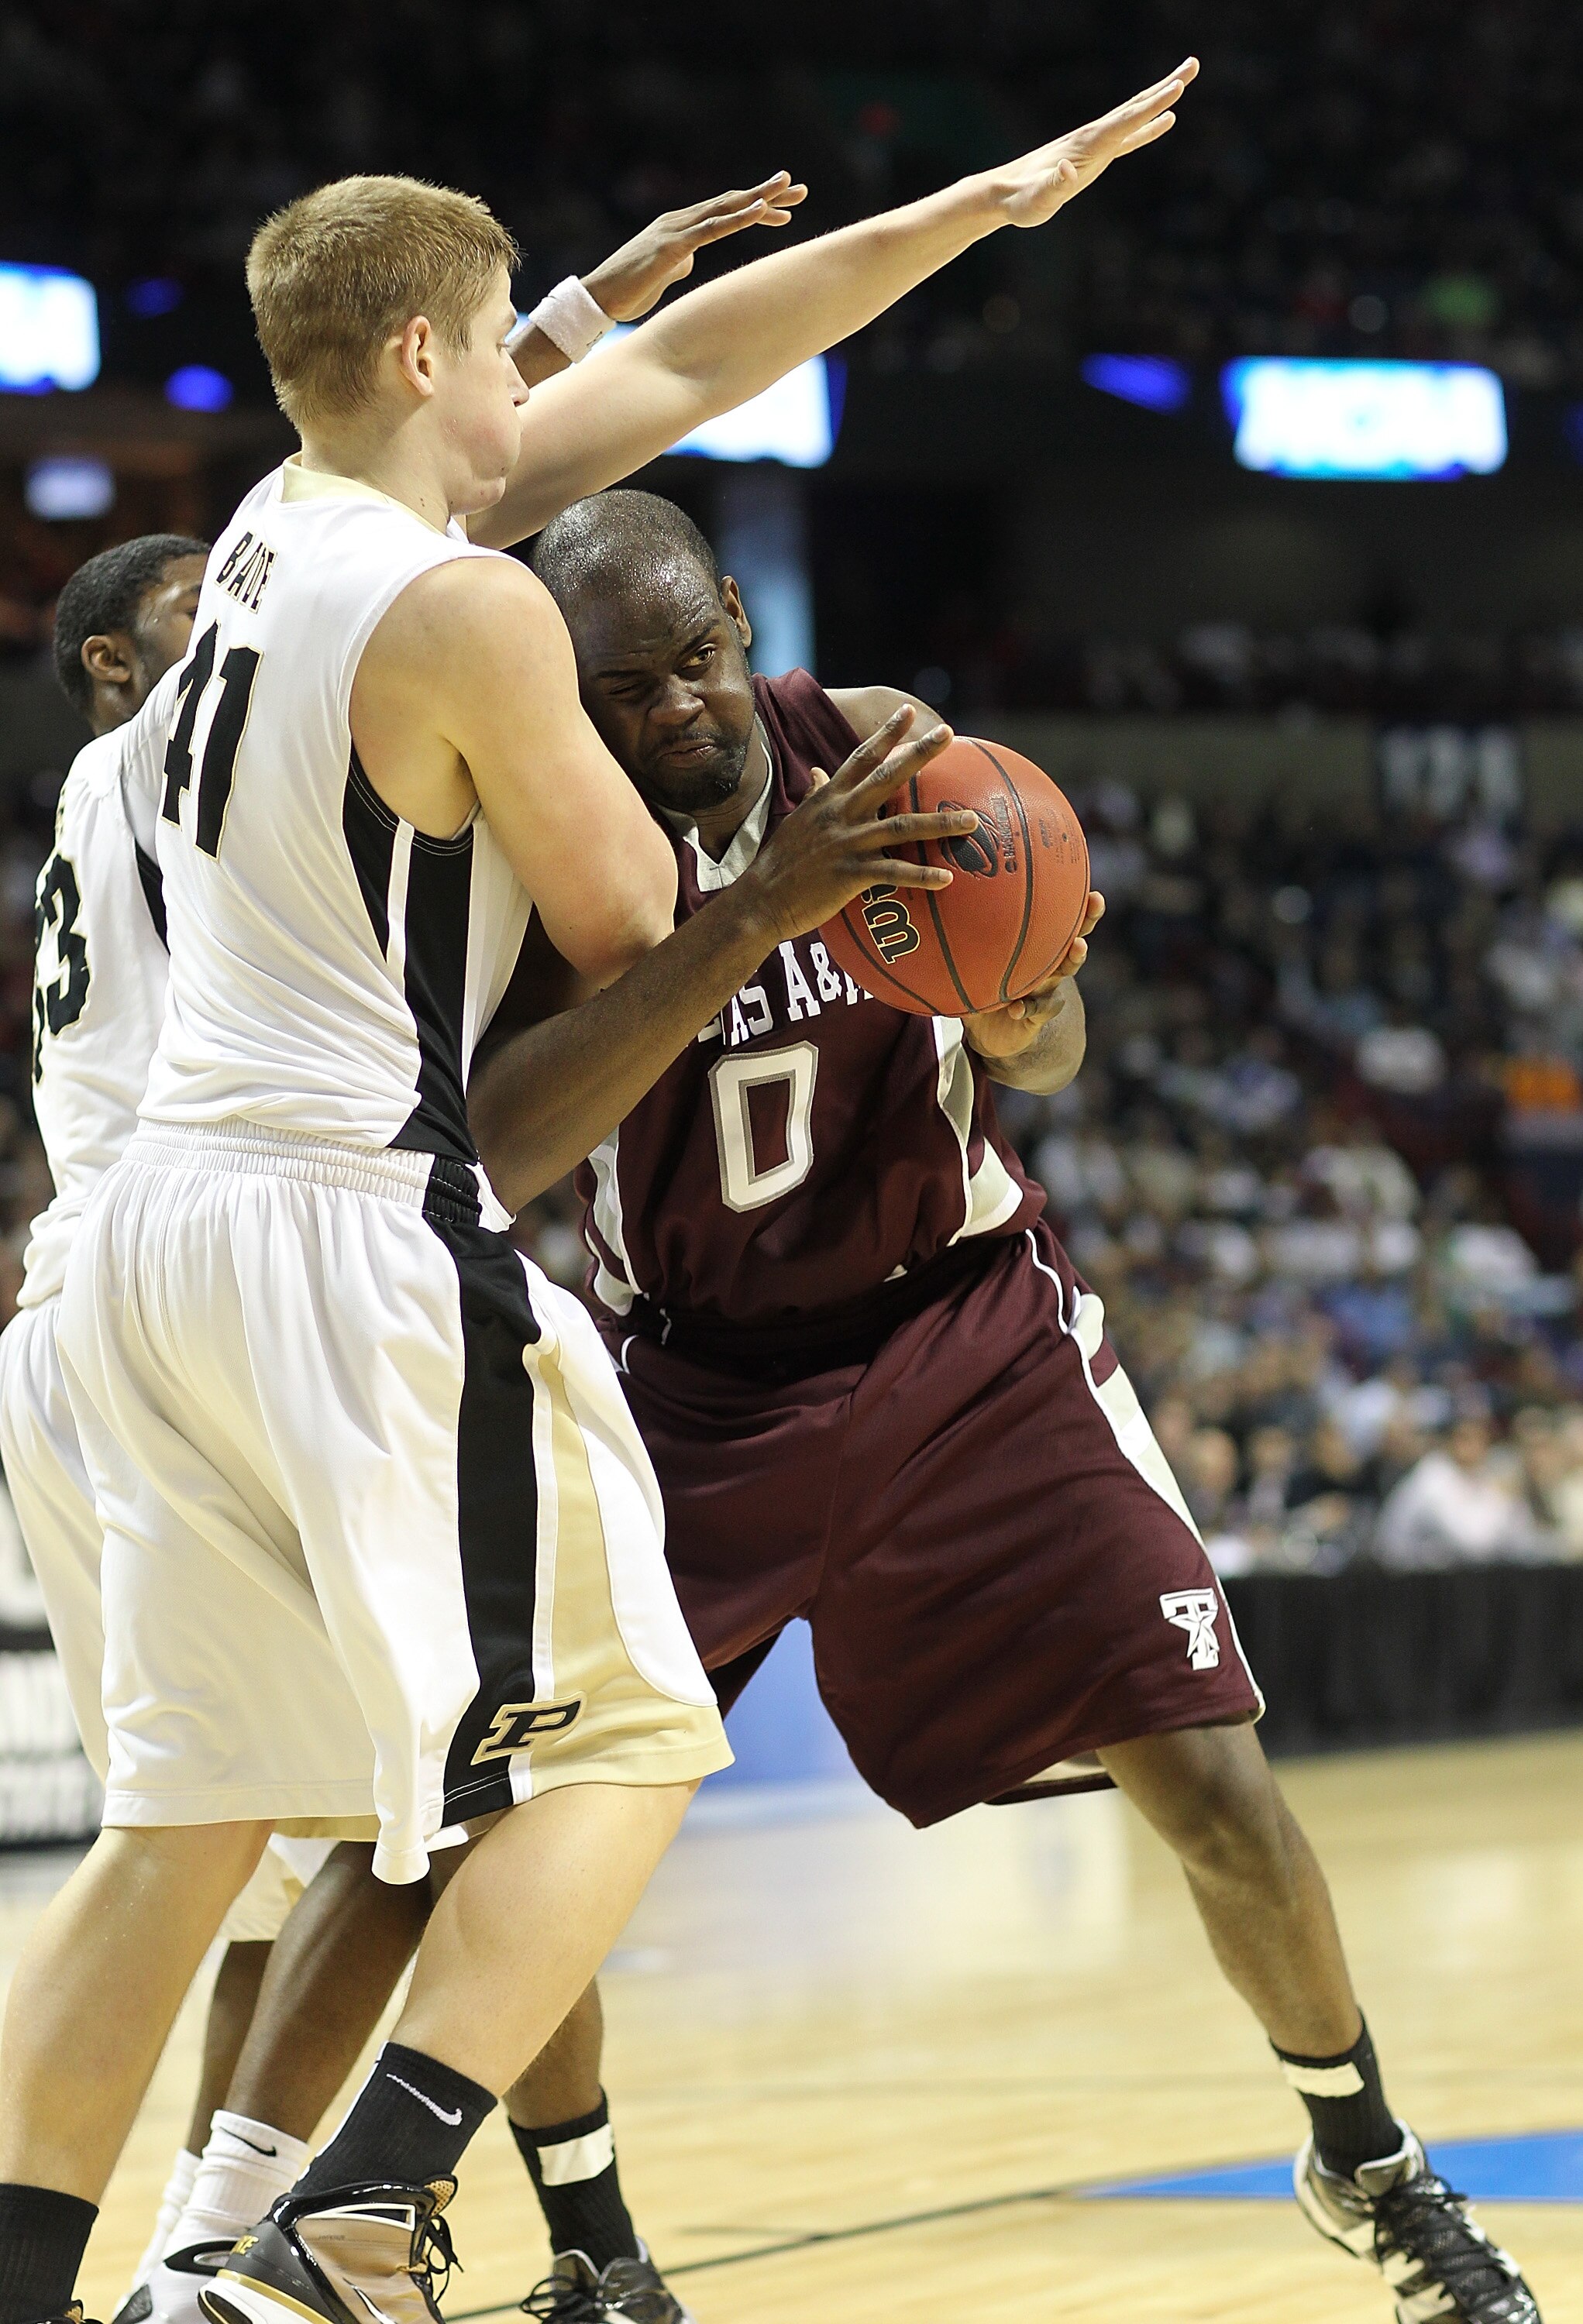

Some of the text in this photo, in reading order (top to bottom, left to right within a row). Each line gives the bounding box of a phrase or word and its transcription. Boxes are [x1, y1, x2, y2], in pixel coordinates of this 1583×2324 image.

[160, 619, 264, 864] 41
[33, 853, 92, 1085] 3
[708, 1040, 819, 1213] 0
[472, 1693, 586, 1764] P
